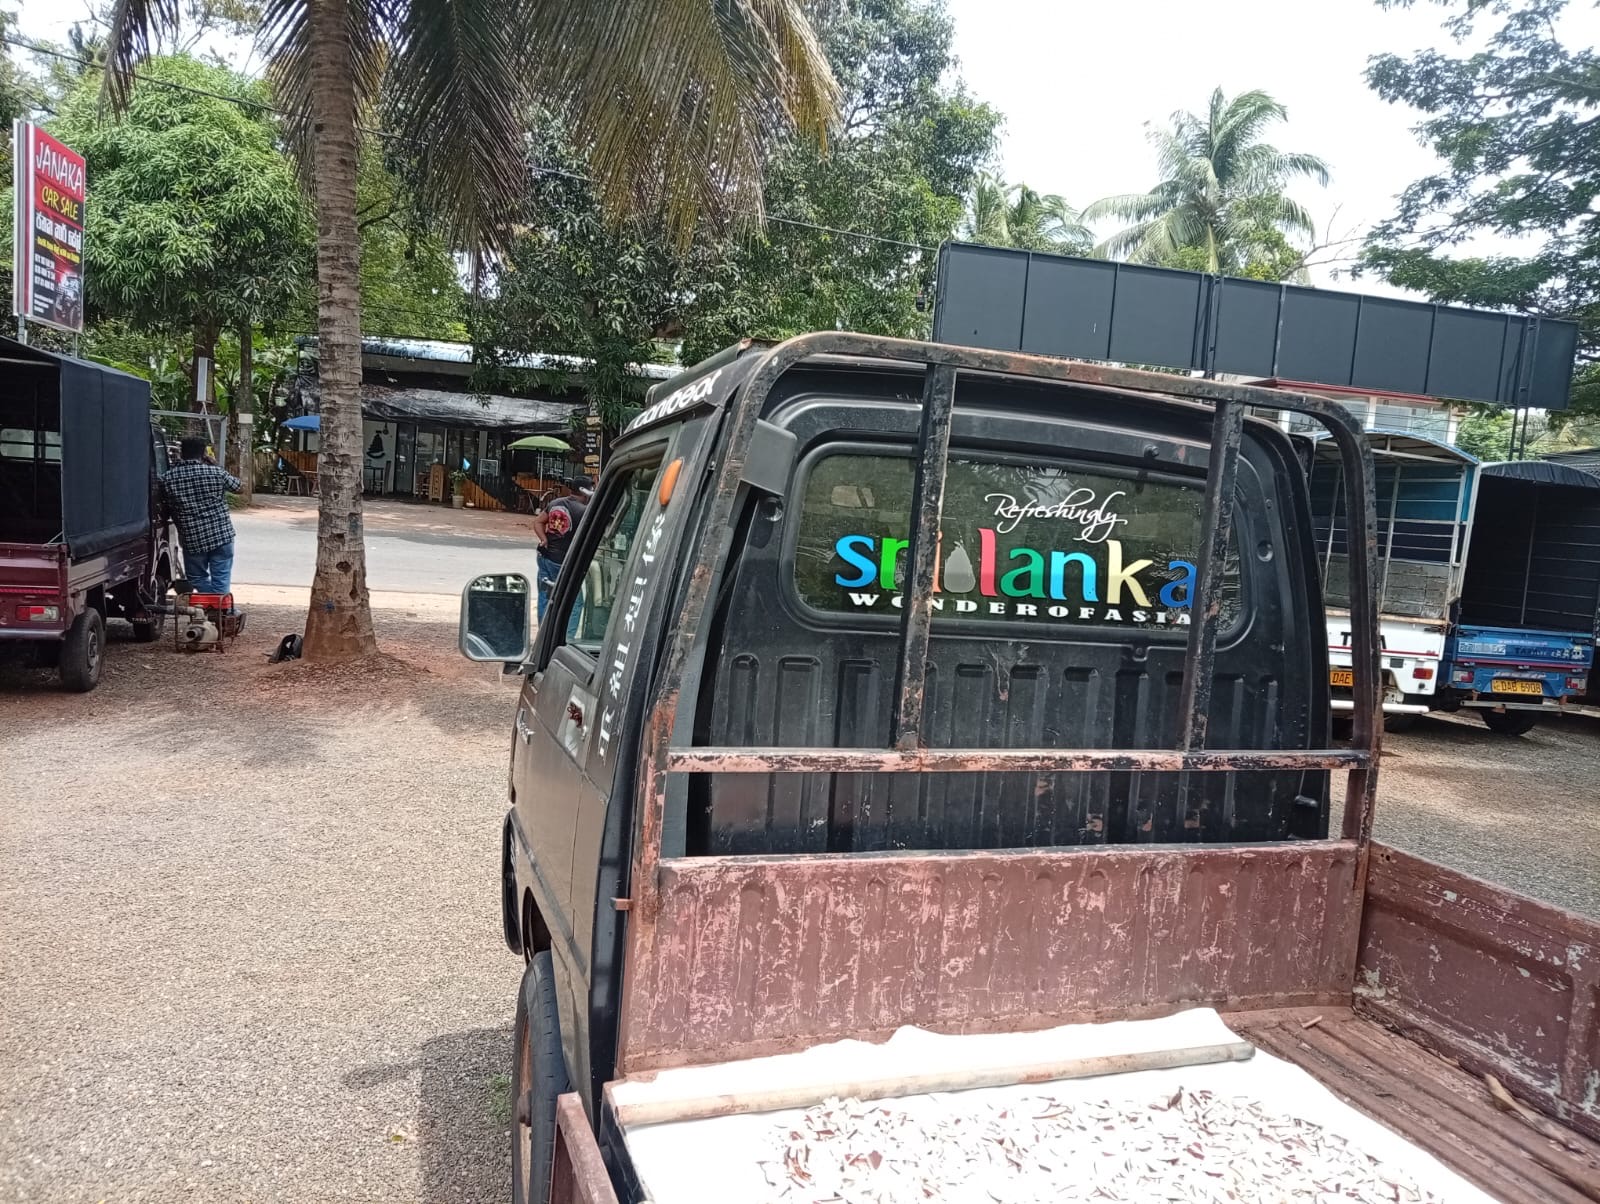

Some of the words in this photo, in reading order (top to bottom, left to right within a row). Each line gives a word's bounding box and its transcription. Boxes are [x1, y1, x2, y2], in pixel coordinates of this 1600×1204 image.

[36, 141, 82, 197] JANAKA
[42, 185, 60, 212] CAR
[60, 196, 79, 221] SALE
[984, 487, 1128, 543] Refreshingly
[977, 527, 1198, 609] lanka
